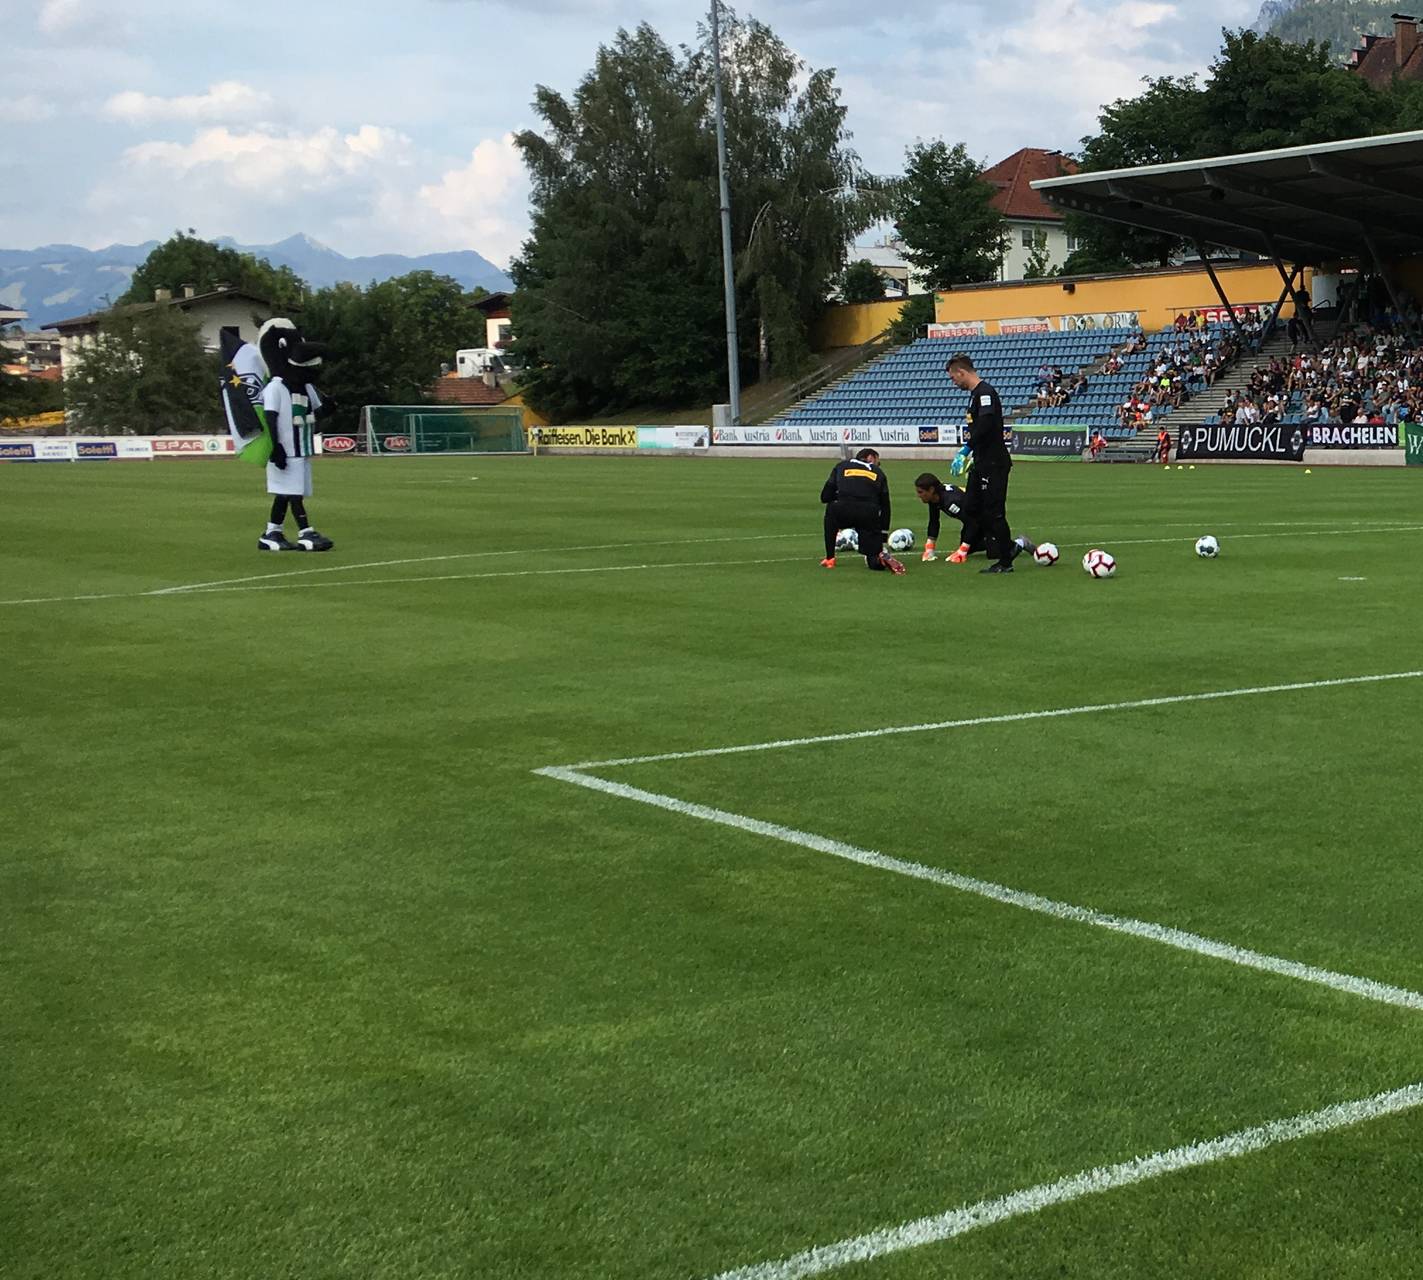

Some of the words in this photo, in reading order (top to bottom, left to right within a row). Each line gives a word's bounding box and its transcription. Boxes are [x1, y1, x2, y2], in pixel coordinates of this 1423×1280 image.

[585, 428, 600, 445] Die
[602, 428, 628, 445] Bank
[744, 428, 769, 440] Austria
[783, 428, 803, 440] Bank
[809, 428, 838, 440] Austria
[851, 428, 871, 440] Bank
[879, 428, 910, 440] Austria
[1193, 426, 1287, 453] PUMUCKL
[1312, 427, 1397, 444] BRACHELEN
[0, 446, 33, 456] oletti
[155, 441, 203, 450] SPAR
